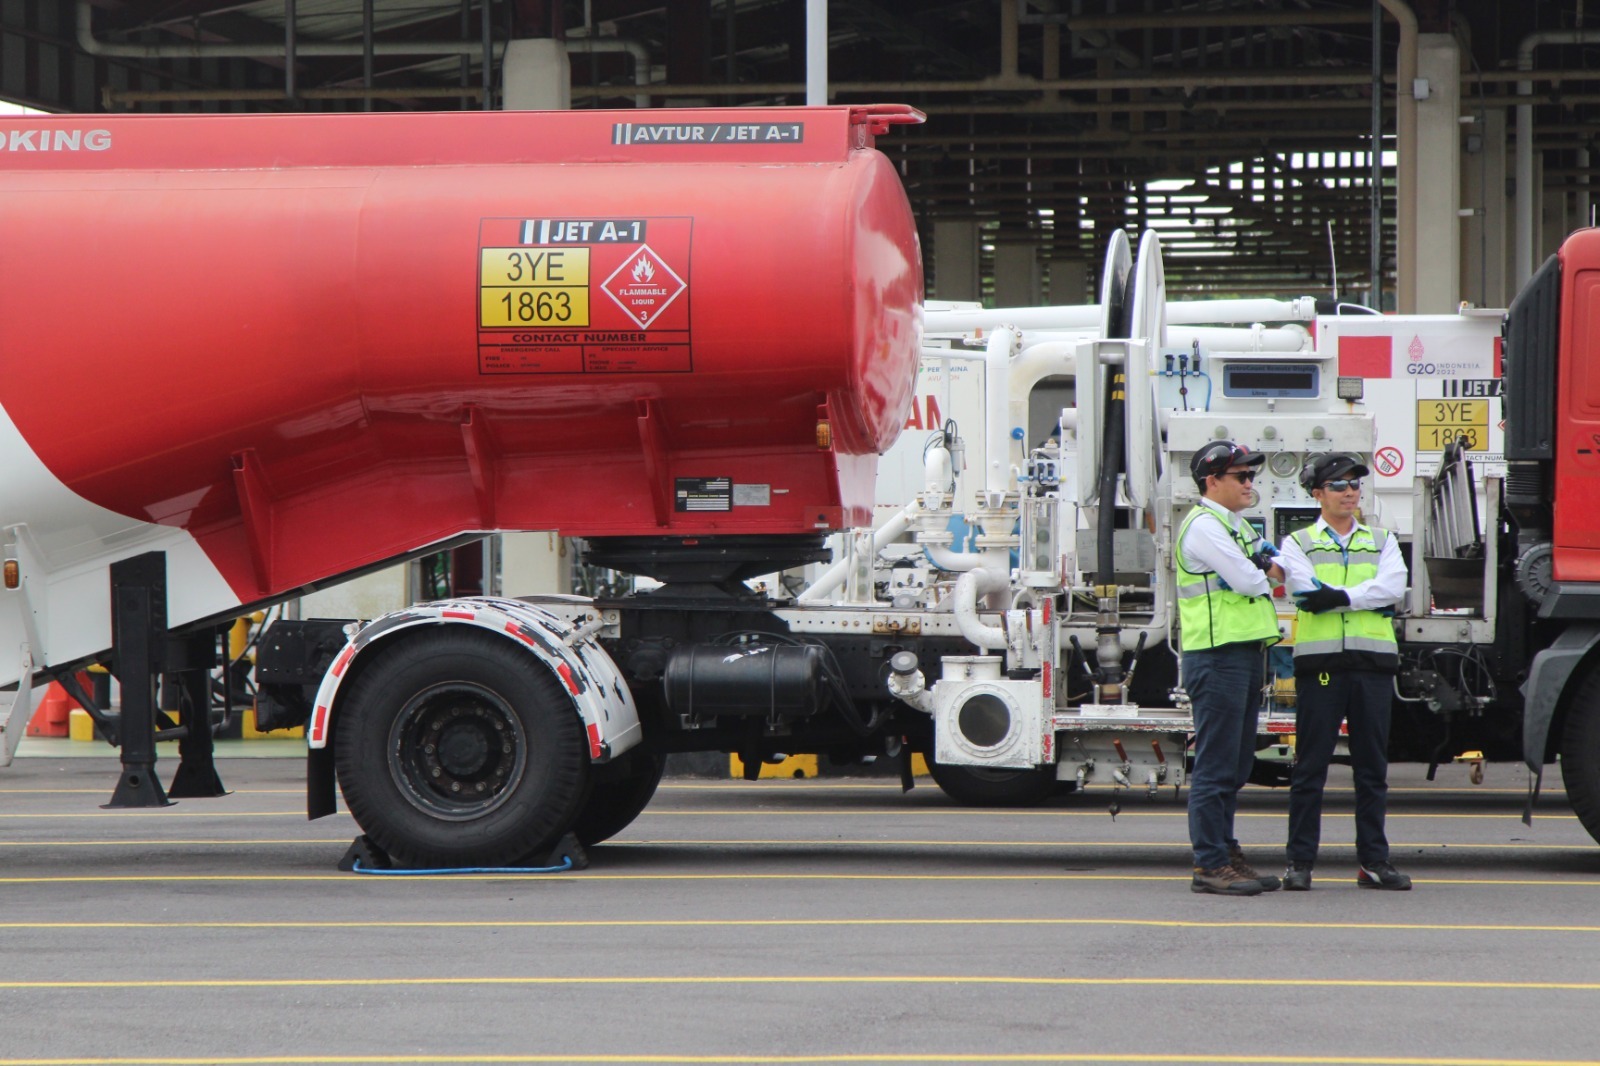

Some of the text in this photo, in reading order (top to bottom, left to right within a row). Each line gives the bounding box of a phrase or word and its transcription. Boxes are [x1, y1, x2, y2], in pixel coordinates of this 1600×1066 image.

[0, 129, 112, 151] KING
[634, 125, 800, 142] AVTUR / JET A-1
[552, 221, 641, 241] JET A-1
[507, 252, 565, 281] 3YE
[619, 288, 667, 296] FLAMMABLE
[501, 291, 572, 322] 1863
[632, 298, 655, 306] LIQUID
[640, 311, 648, 321] 3
[512, 333, 647, 343] CONTACT NUMBER
[1406, 363, 1436, 375] G20
[1465, 380, 1492, 396] JET
[1435, 402, 1473, 422] 3YE
